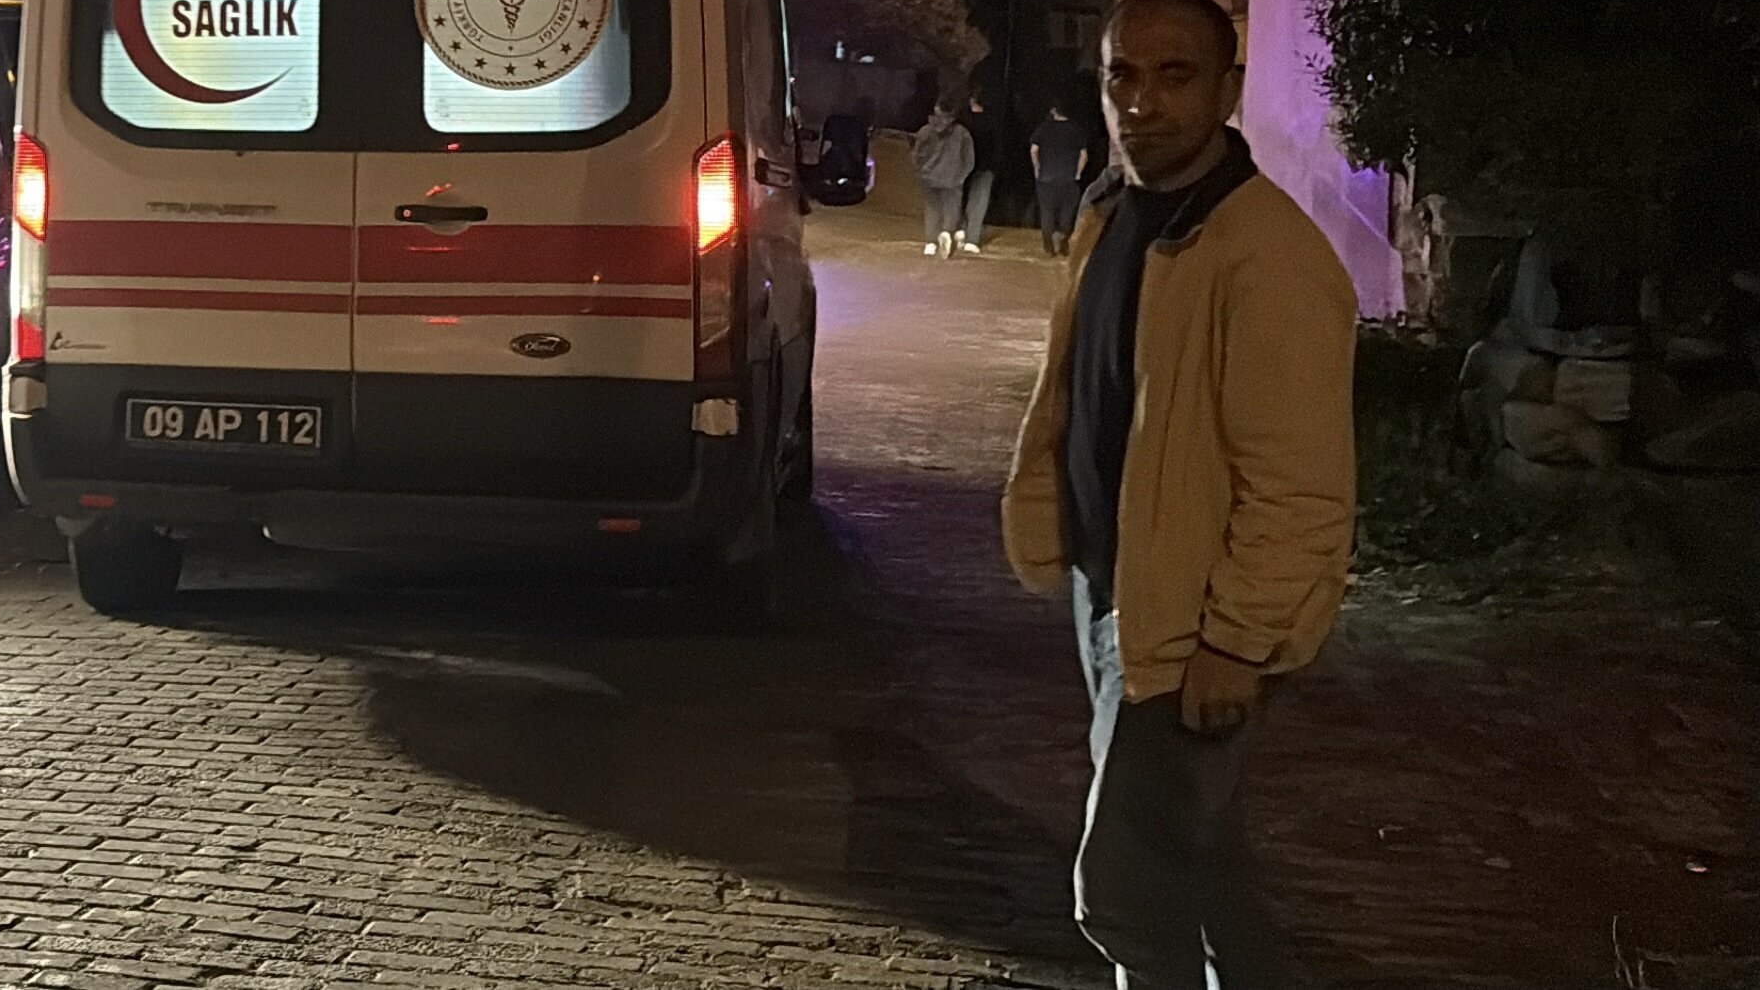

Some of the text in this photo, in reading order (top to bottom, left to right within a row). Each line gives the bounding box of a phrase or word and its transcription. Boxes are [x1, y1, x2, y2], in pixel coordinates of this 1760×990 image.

[143, 406, 315, 444] 09 AP 112
